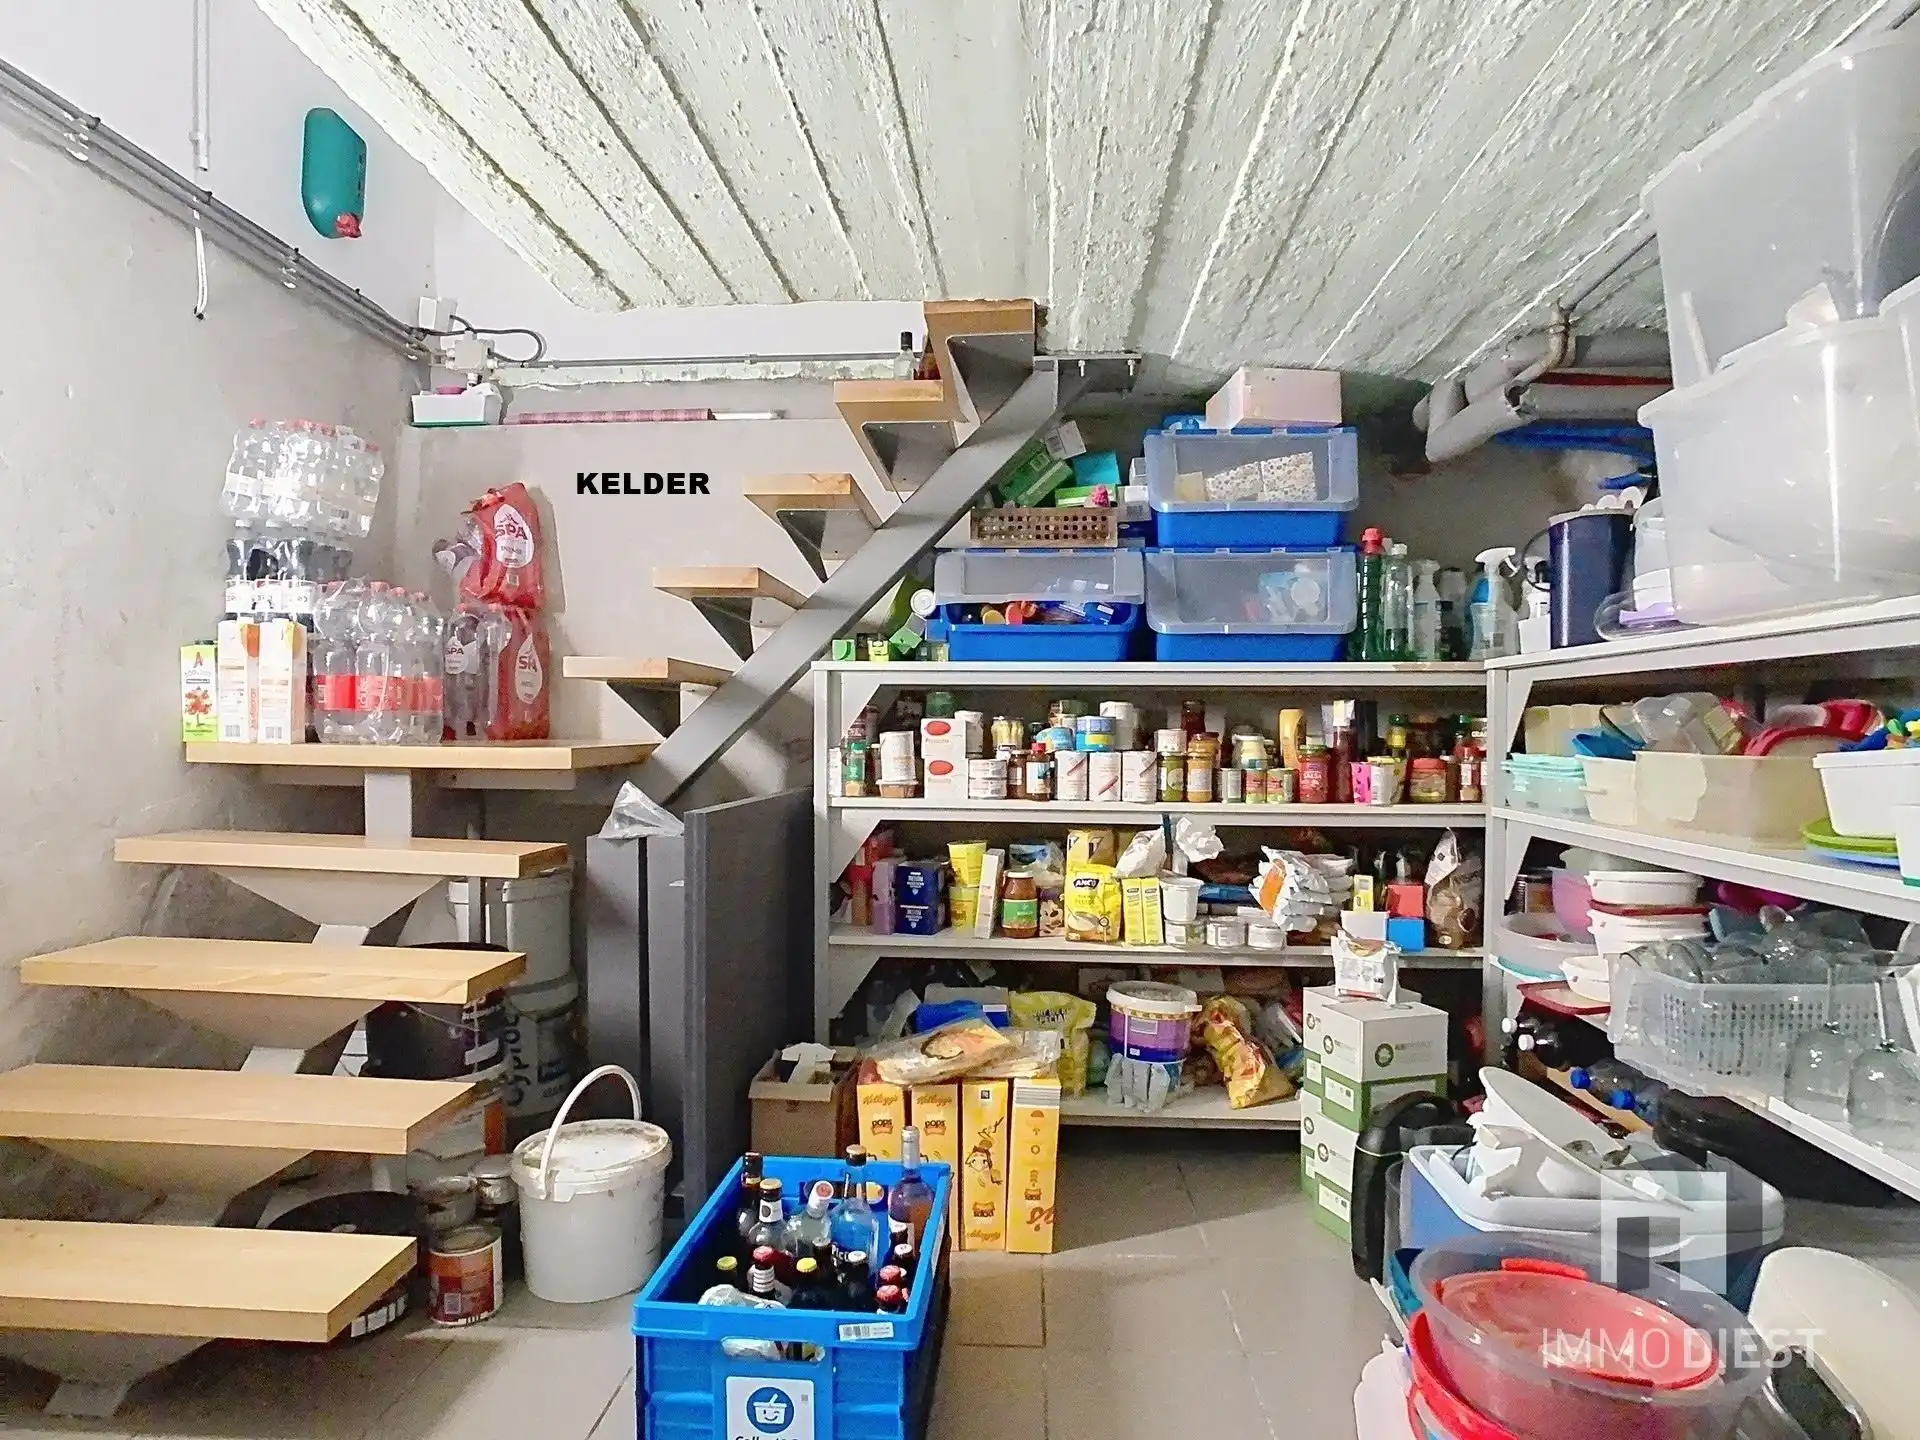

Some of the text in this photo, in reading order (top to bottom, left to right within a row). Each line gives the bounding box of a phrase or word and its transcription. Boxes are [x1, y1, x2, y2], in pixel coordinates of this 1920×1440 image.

[495, 523, 529, 540] SPA
[862, 1093, 898, 1106] Kellogg's
[871, 1119, 893, 1128] pops
[925, 1120, 946, 1128] pops
